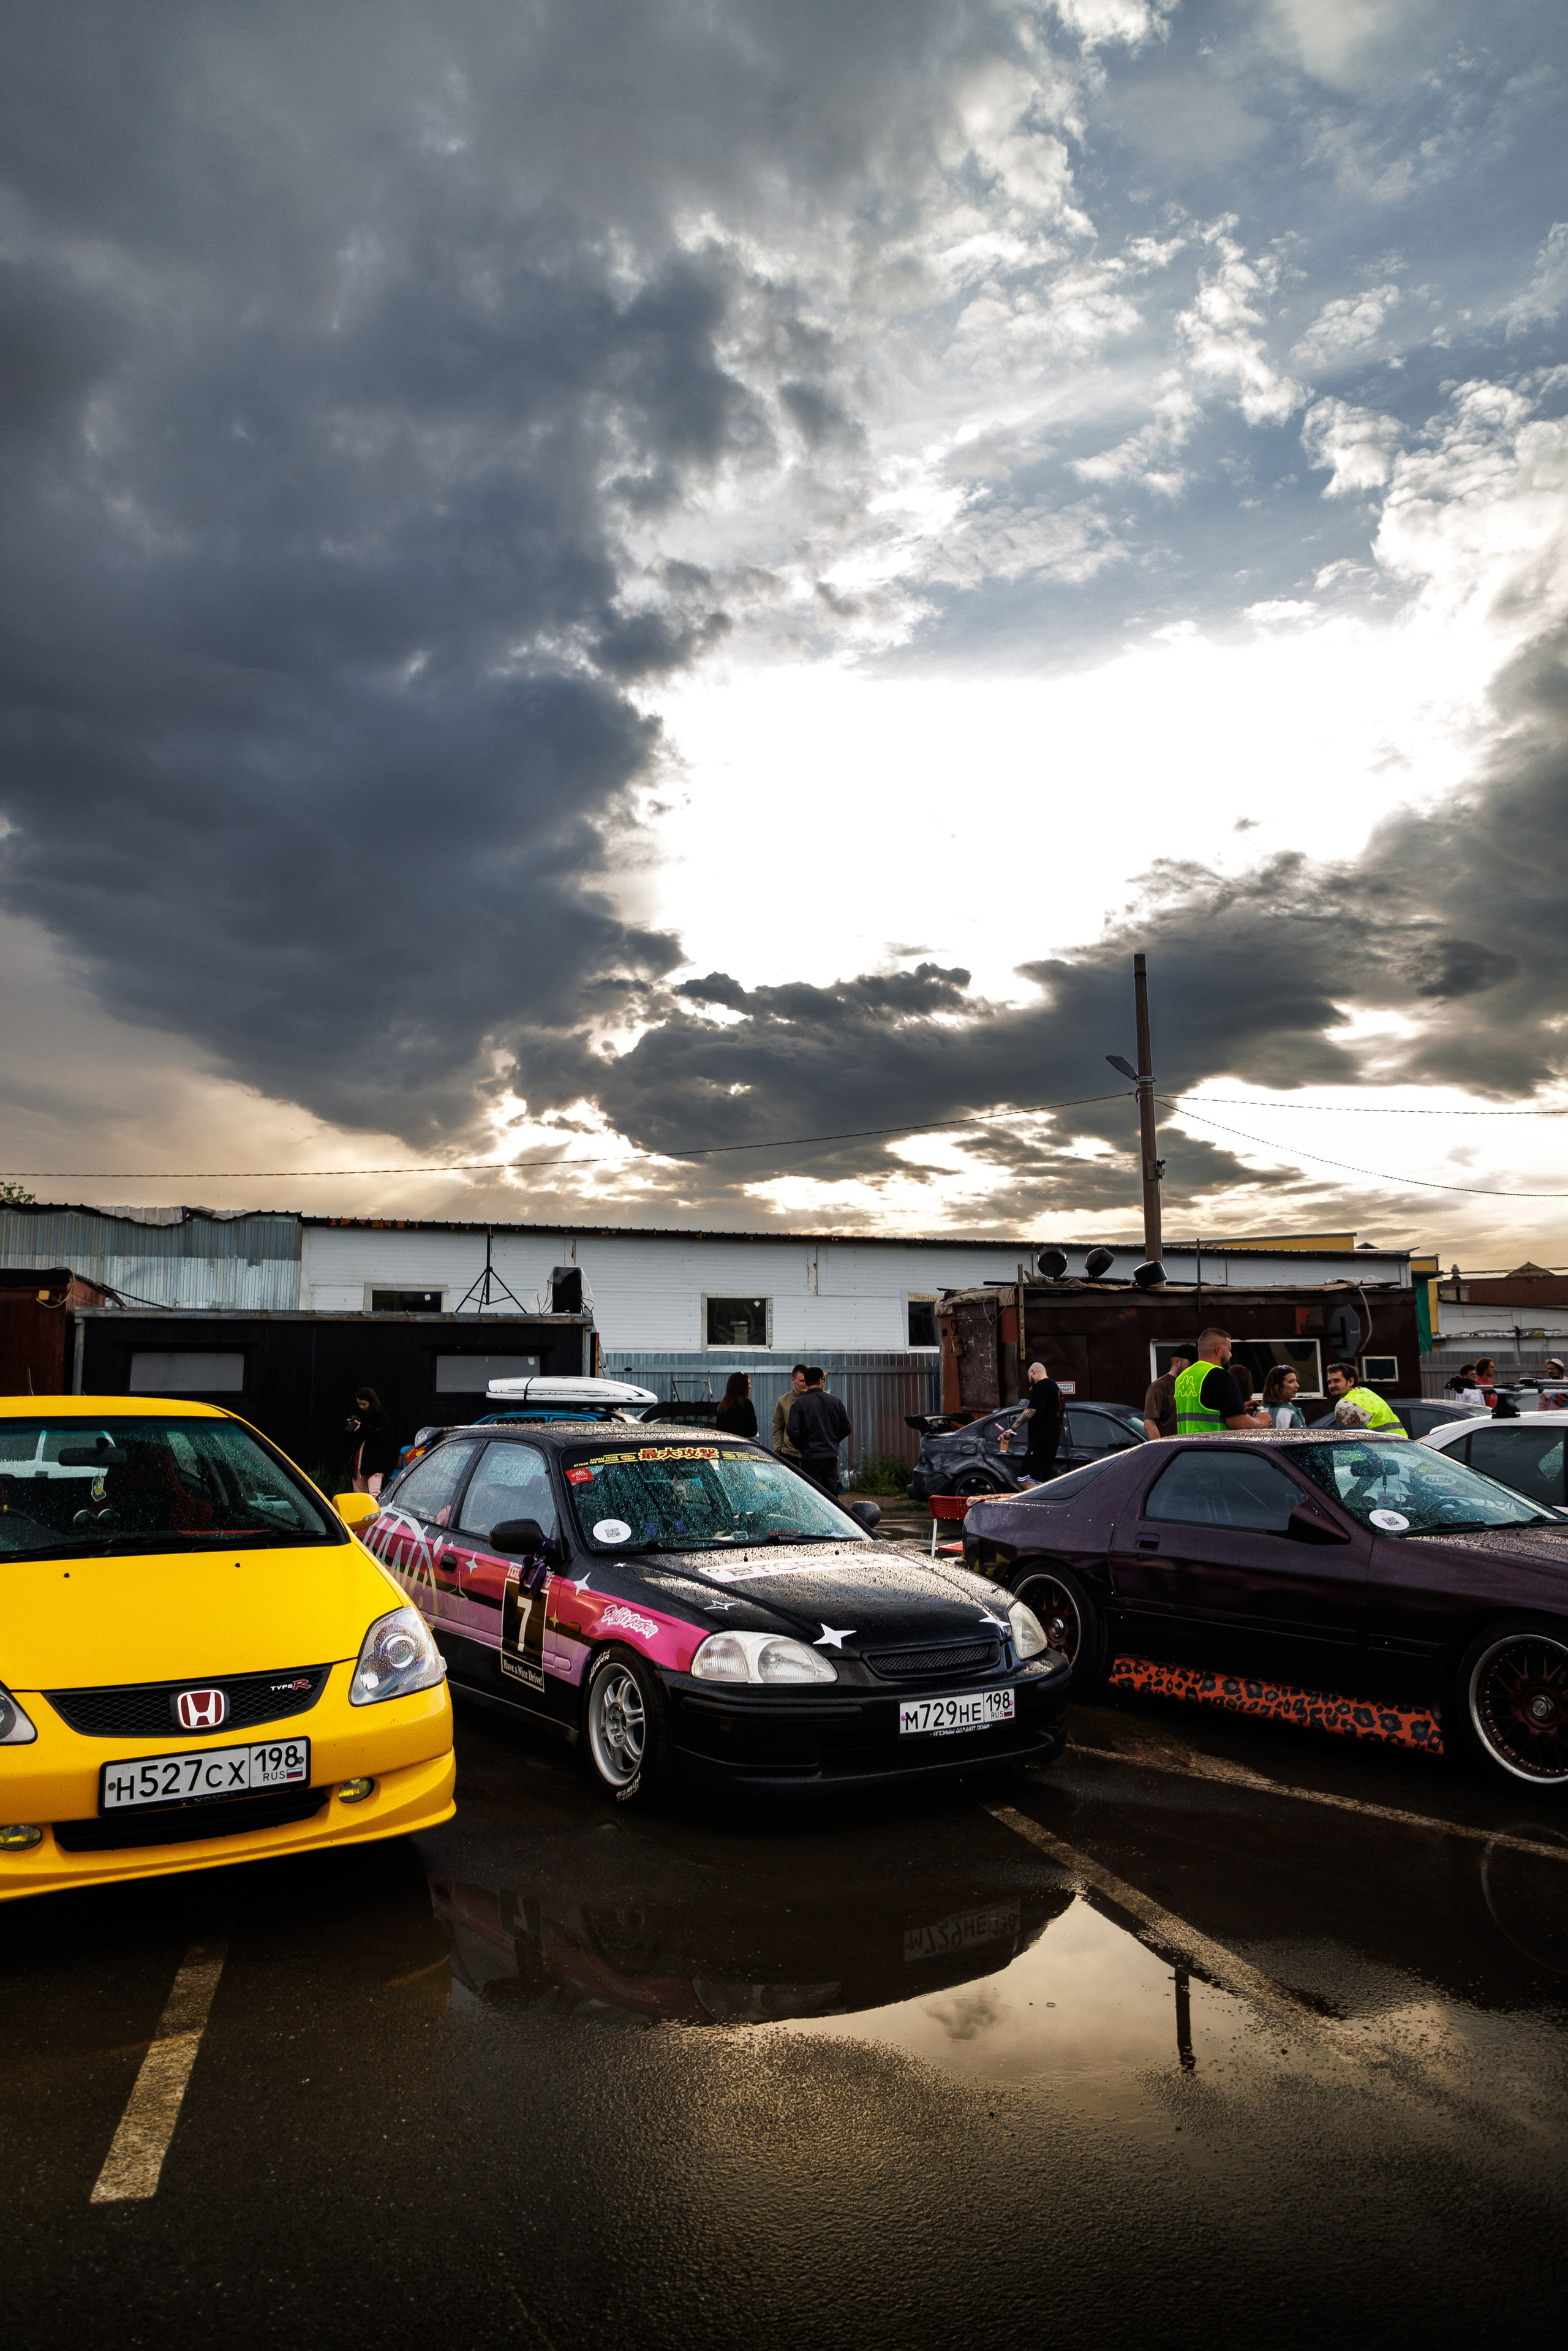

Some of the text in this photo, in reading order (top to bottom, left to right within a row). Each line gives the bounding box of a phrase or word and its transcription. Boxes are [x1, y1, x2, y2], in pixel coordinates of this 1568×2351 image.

[517, 1596, 532, 1653] 7
[503, 1659, 514, 1673] Have
[518, 1665, 528, 1679] Nice
[528, 1670, 543, 1686] Drive!
[905, 1691, 1010, 1731] М729НЕ 198
[990, 1710, 1004, 1719] RUS
[116, 1744, 298, 1802] Н527СХ 198
[263, 1771, 286, 1782] RUS
